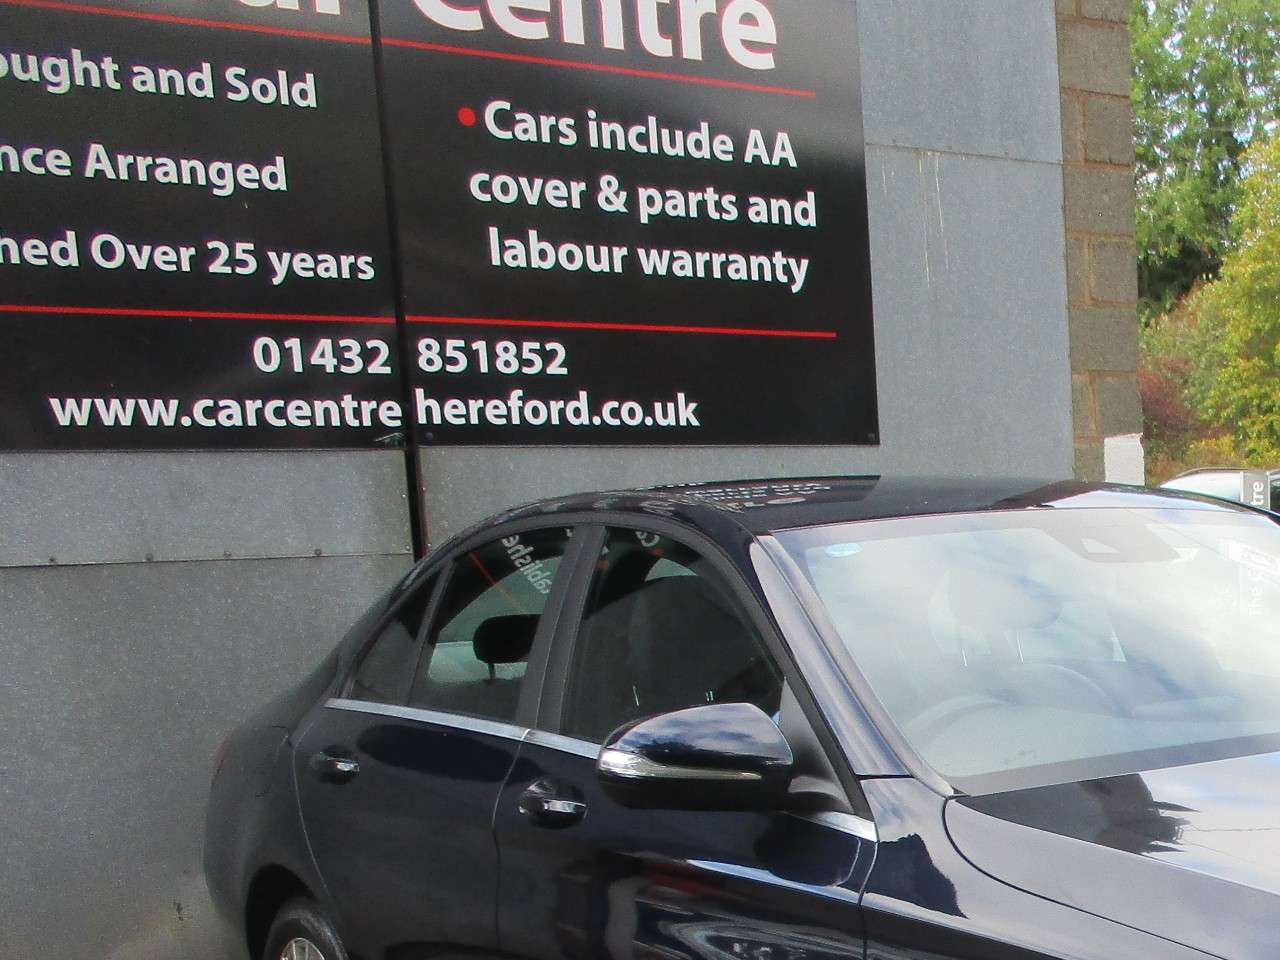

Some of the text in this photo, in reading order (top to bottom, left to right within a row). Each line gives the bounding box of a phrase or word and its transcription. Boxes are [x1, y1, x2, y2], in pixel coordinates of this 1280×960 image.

[131, 61, 215, 98] and
[224, 66, 317, 108] Sold
[484, 100, 798, 168] Cars include AA
[0, 143, 288, 197] nce Arranged
[469, 172, 817, 227] cover & parts and
[90, 233, 196, 272] Over
[206, 240, 258, 275] 25
[266, 242, 375, 286] years
[488, 226, 809, 294] labour warranty
[253, 336, 568, 375] 01432 851852
